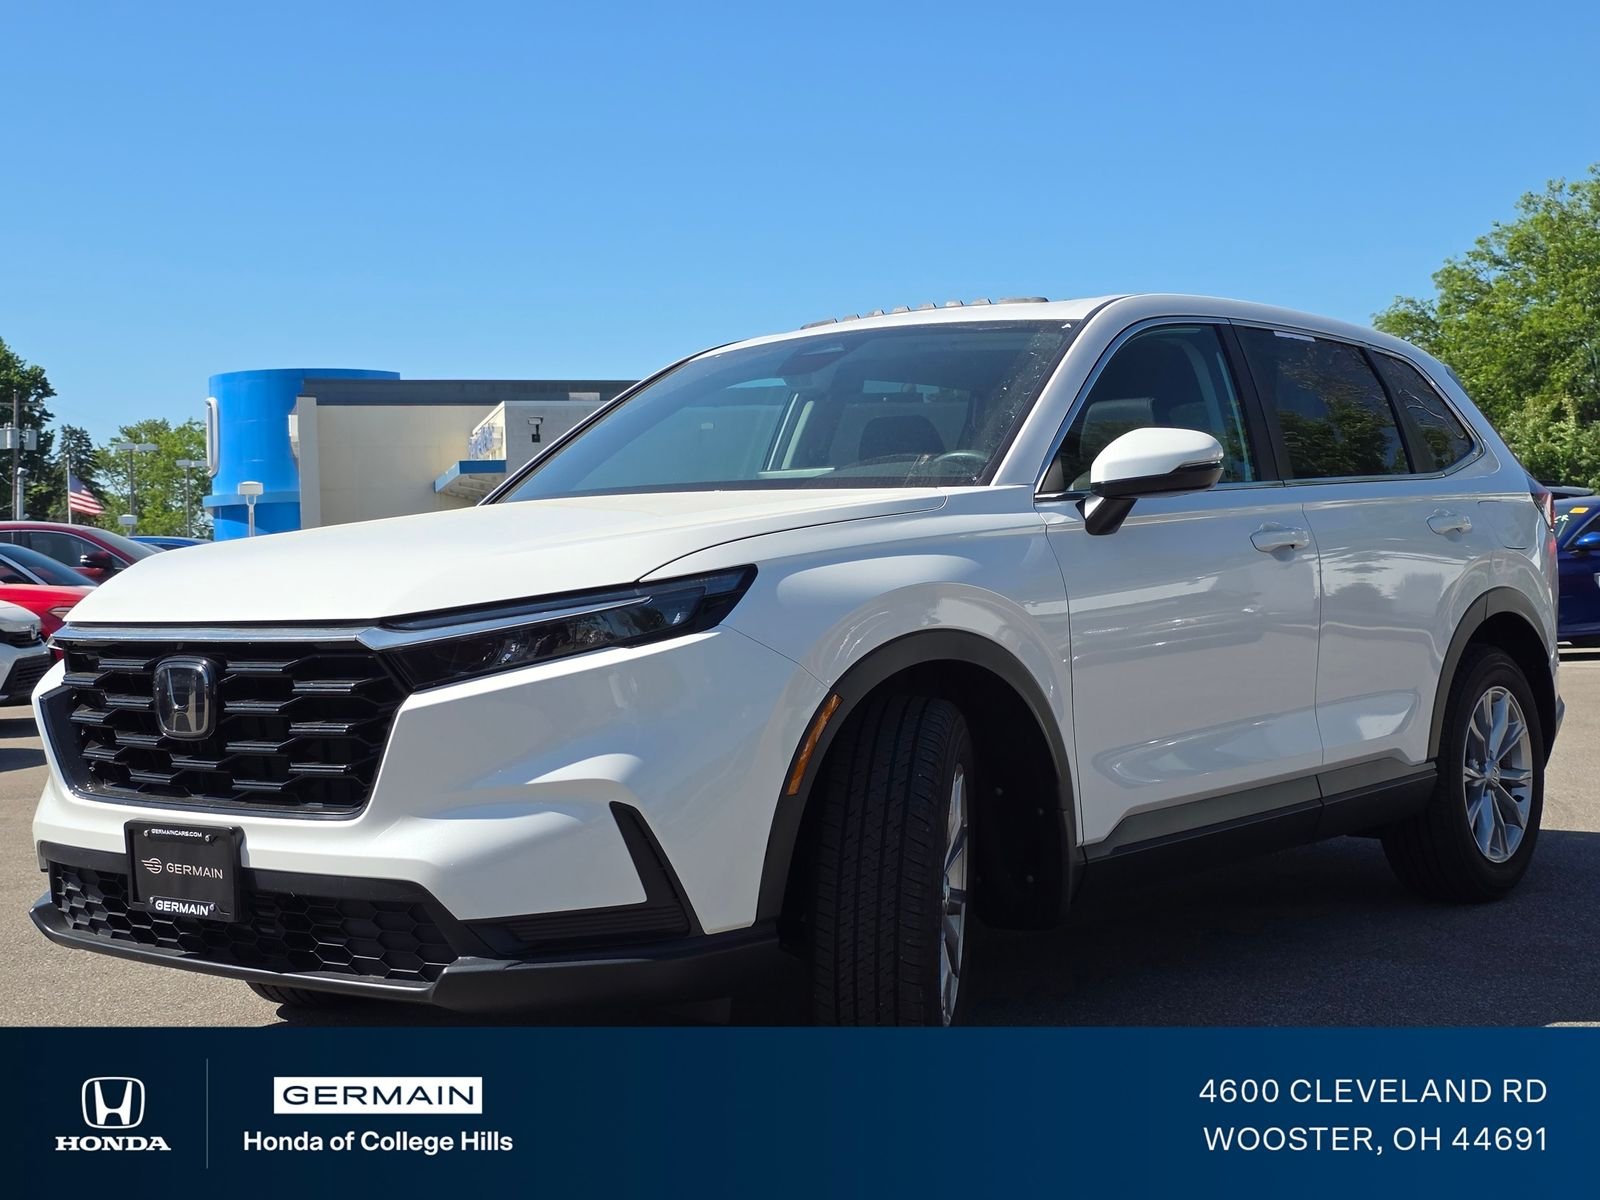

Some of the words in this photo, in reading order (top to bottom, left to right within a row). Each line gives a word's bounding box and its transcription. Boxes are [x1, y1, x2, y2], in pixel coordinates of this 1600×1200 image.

[151, 828, 202, 838] GERMAINCARS.COM
[166, 862, 223, 879] GERMAIN
[155, 900, 209, 916] GERMAIN
